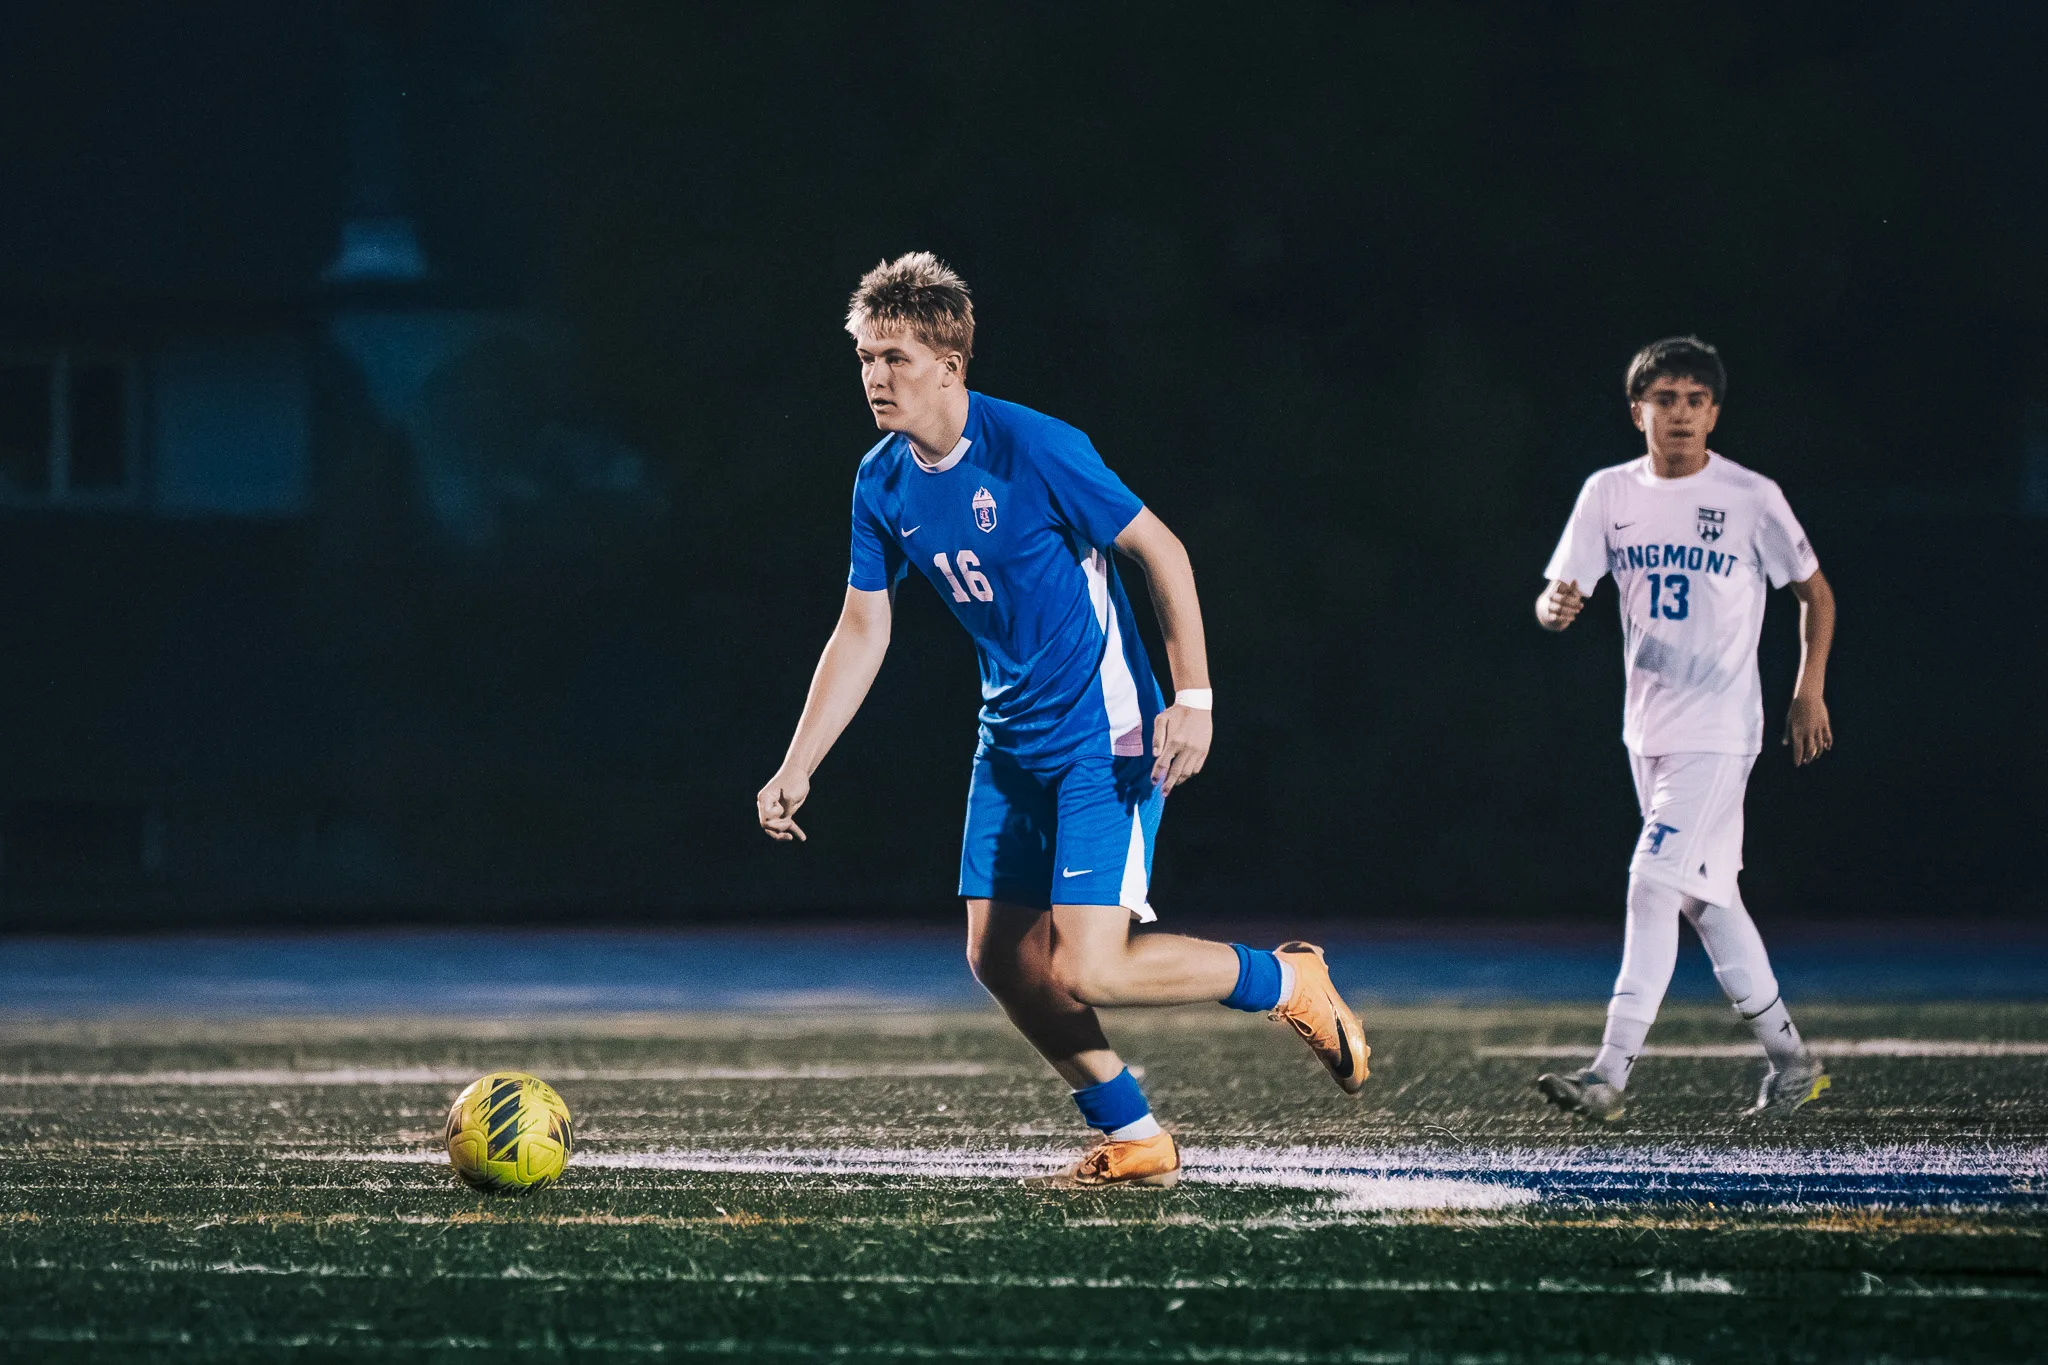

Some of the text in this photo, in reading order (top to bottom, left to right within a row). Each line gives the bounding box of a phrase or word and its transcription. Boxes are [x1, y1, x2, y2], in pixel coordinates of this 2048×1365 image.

[933, 549, 994, 602] 16
[1609, 543, 1739, 577] ONGMONT
[1647, 573, 1690, 620] 13
